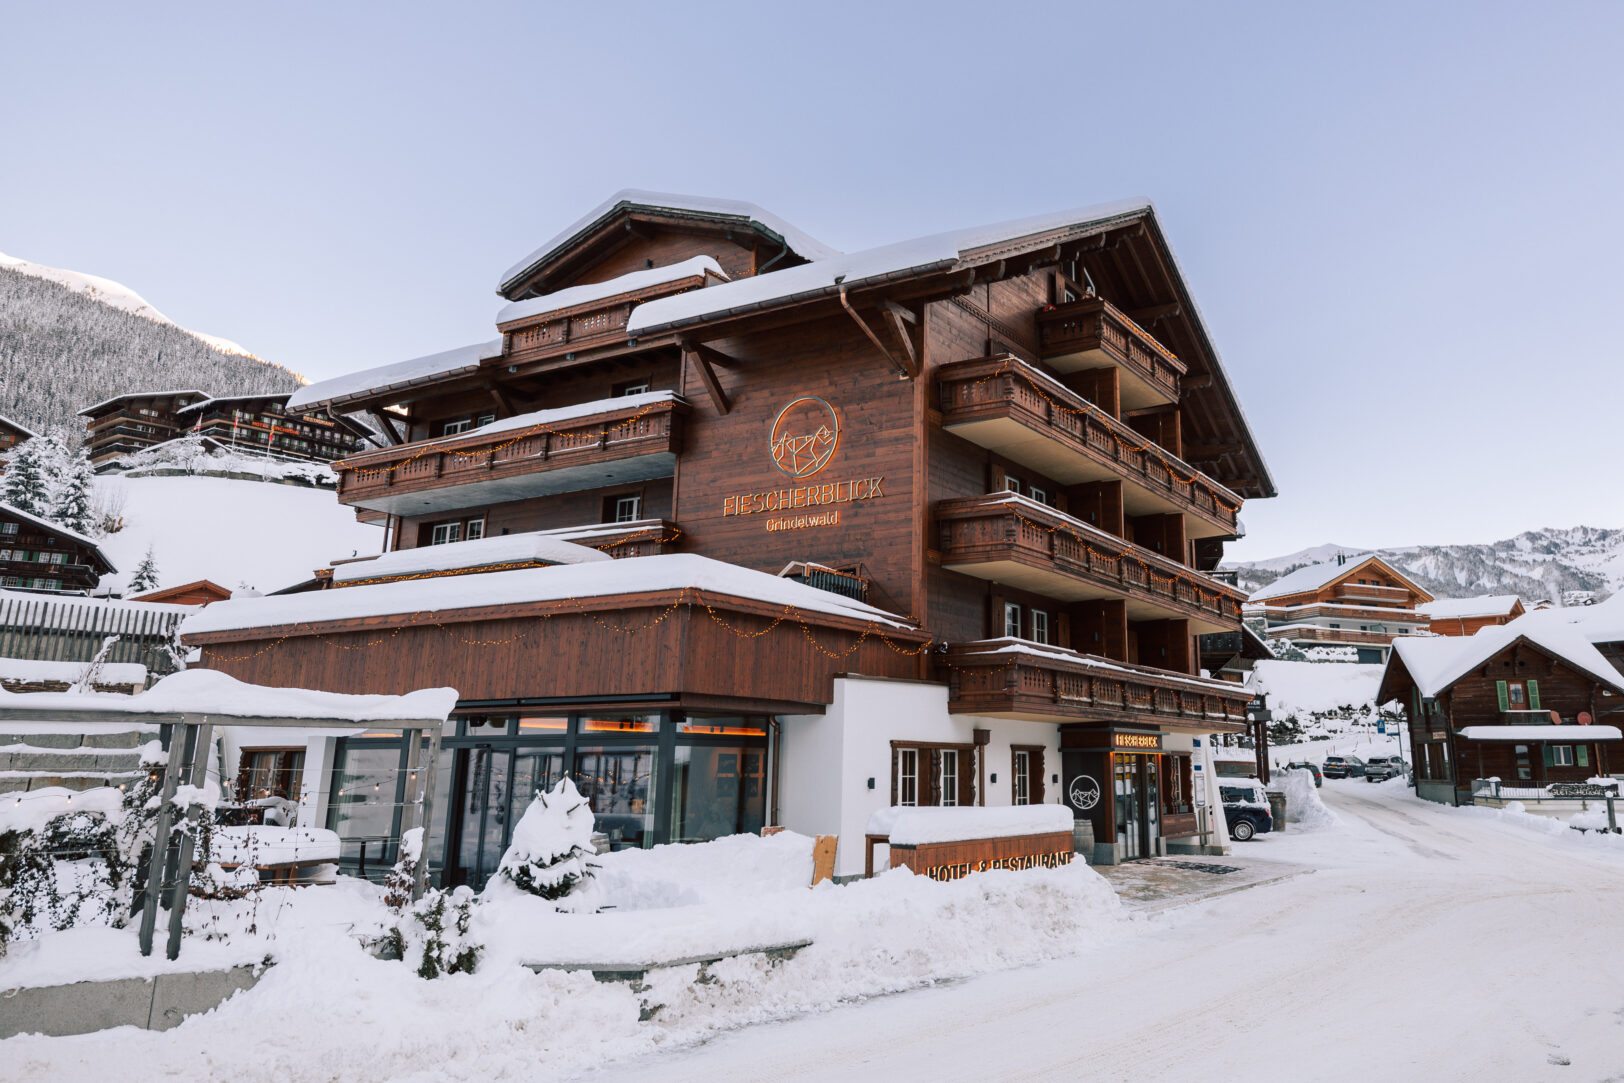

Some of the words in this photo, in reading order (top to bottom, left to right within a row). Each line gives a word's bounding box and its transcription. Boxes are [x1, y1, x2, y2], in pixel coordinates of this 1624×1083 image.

[722, 476, 885, 516] FIESCHERBLICK
[766, 511, 838, 532] Grindelwald
[990, 851, 1073, 871] RESTAURANT
